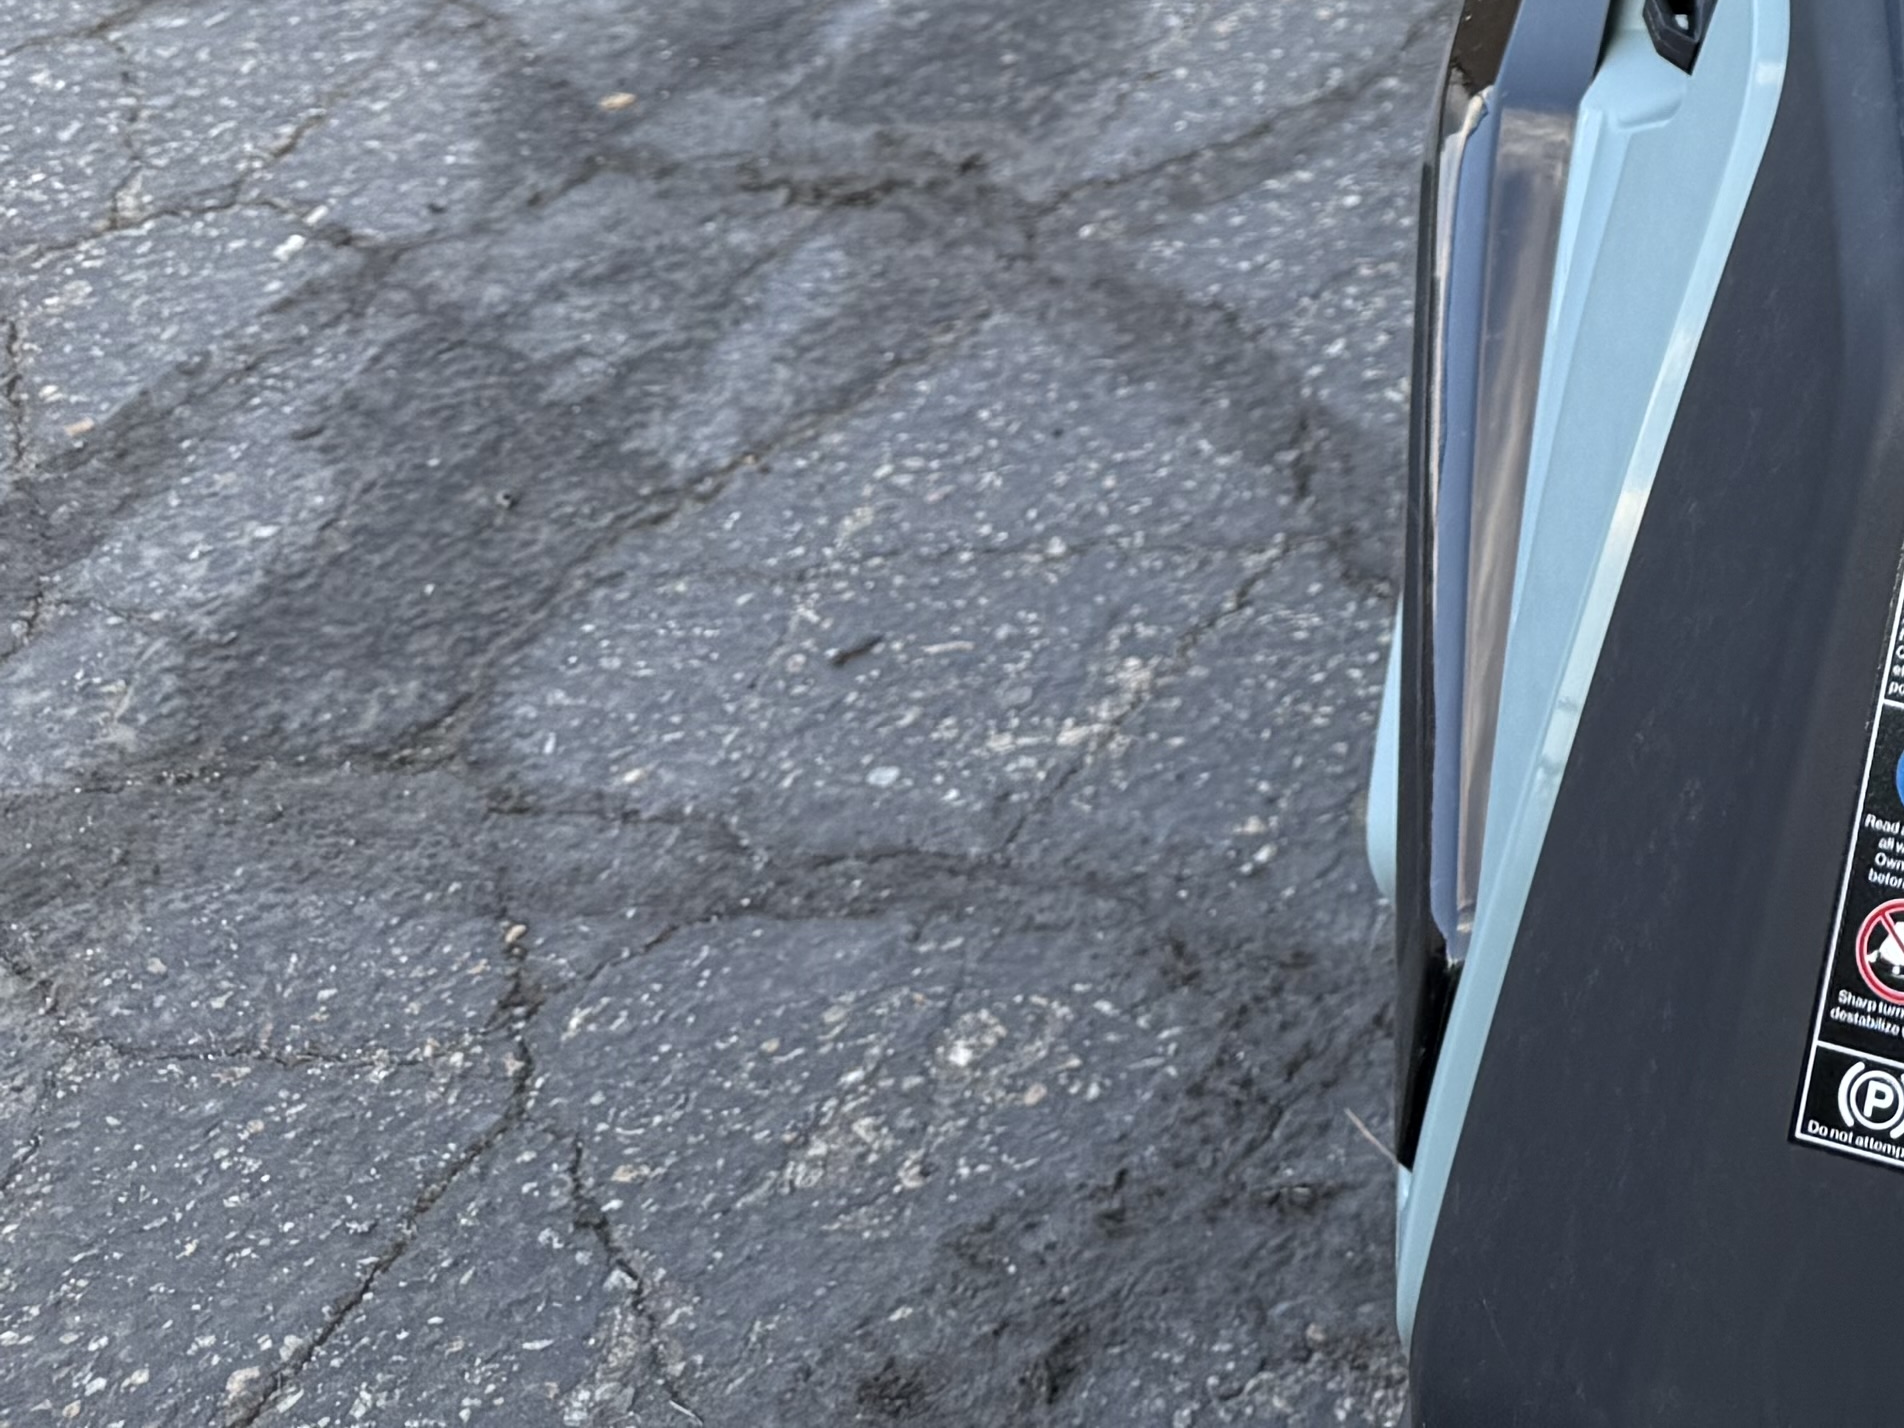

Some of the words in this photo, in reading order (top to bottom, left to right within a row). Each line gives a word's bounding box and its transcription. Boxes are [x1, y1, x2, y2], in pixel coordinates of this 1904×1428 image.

[1864, 813, 1900, 834] Read
[1877, 836, 1895, 851] all
[1837, 989, 1877, 1014] Sharp
[1829, 1005, 1900, 1036] destabilize
[1806, 1119, 1829, 1137] Do
[1829, 1128, 1854, 1144] not
